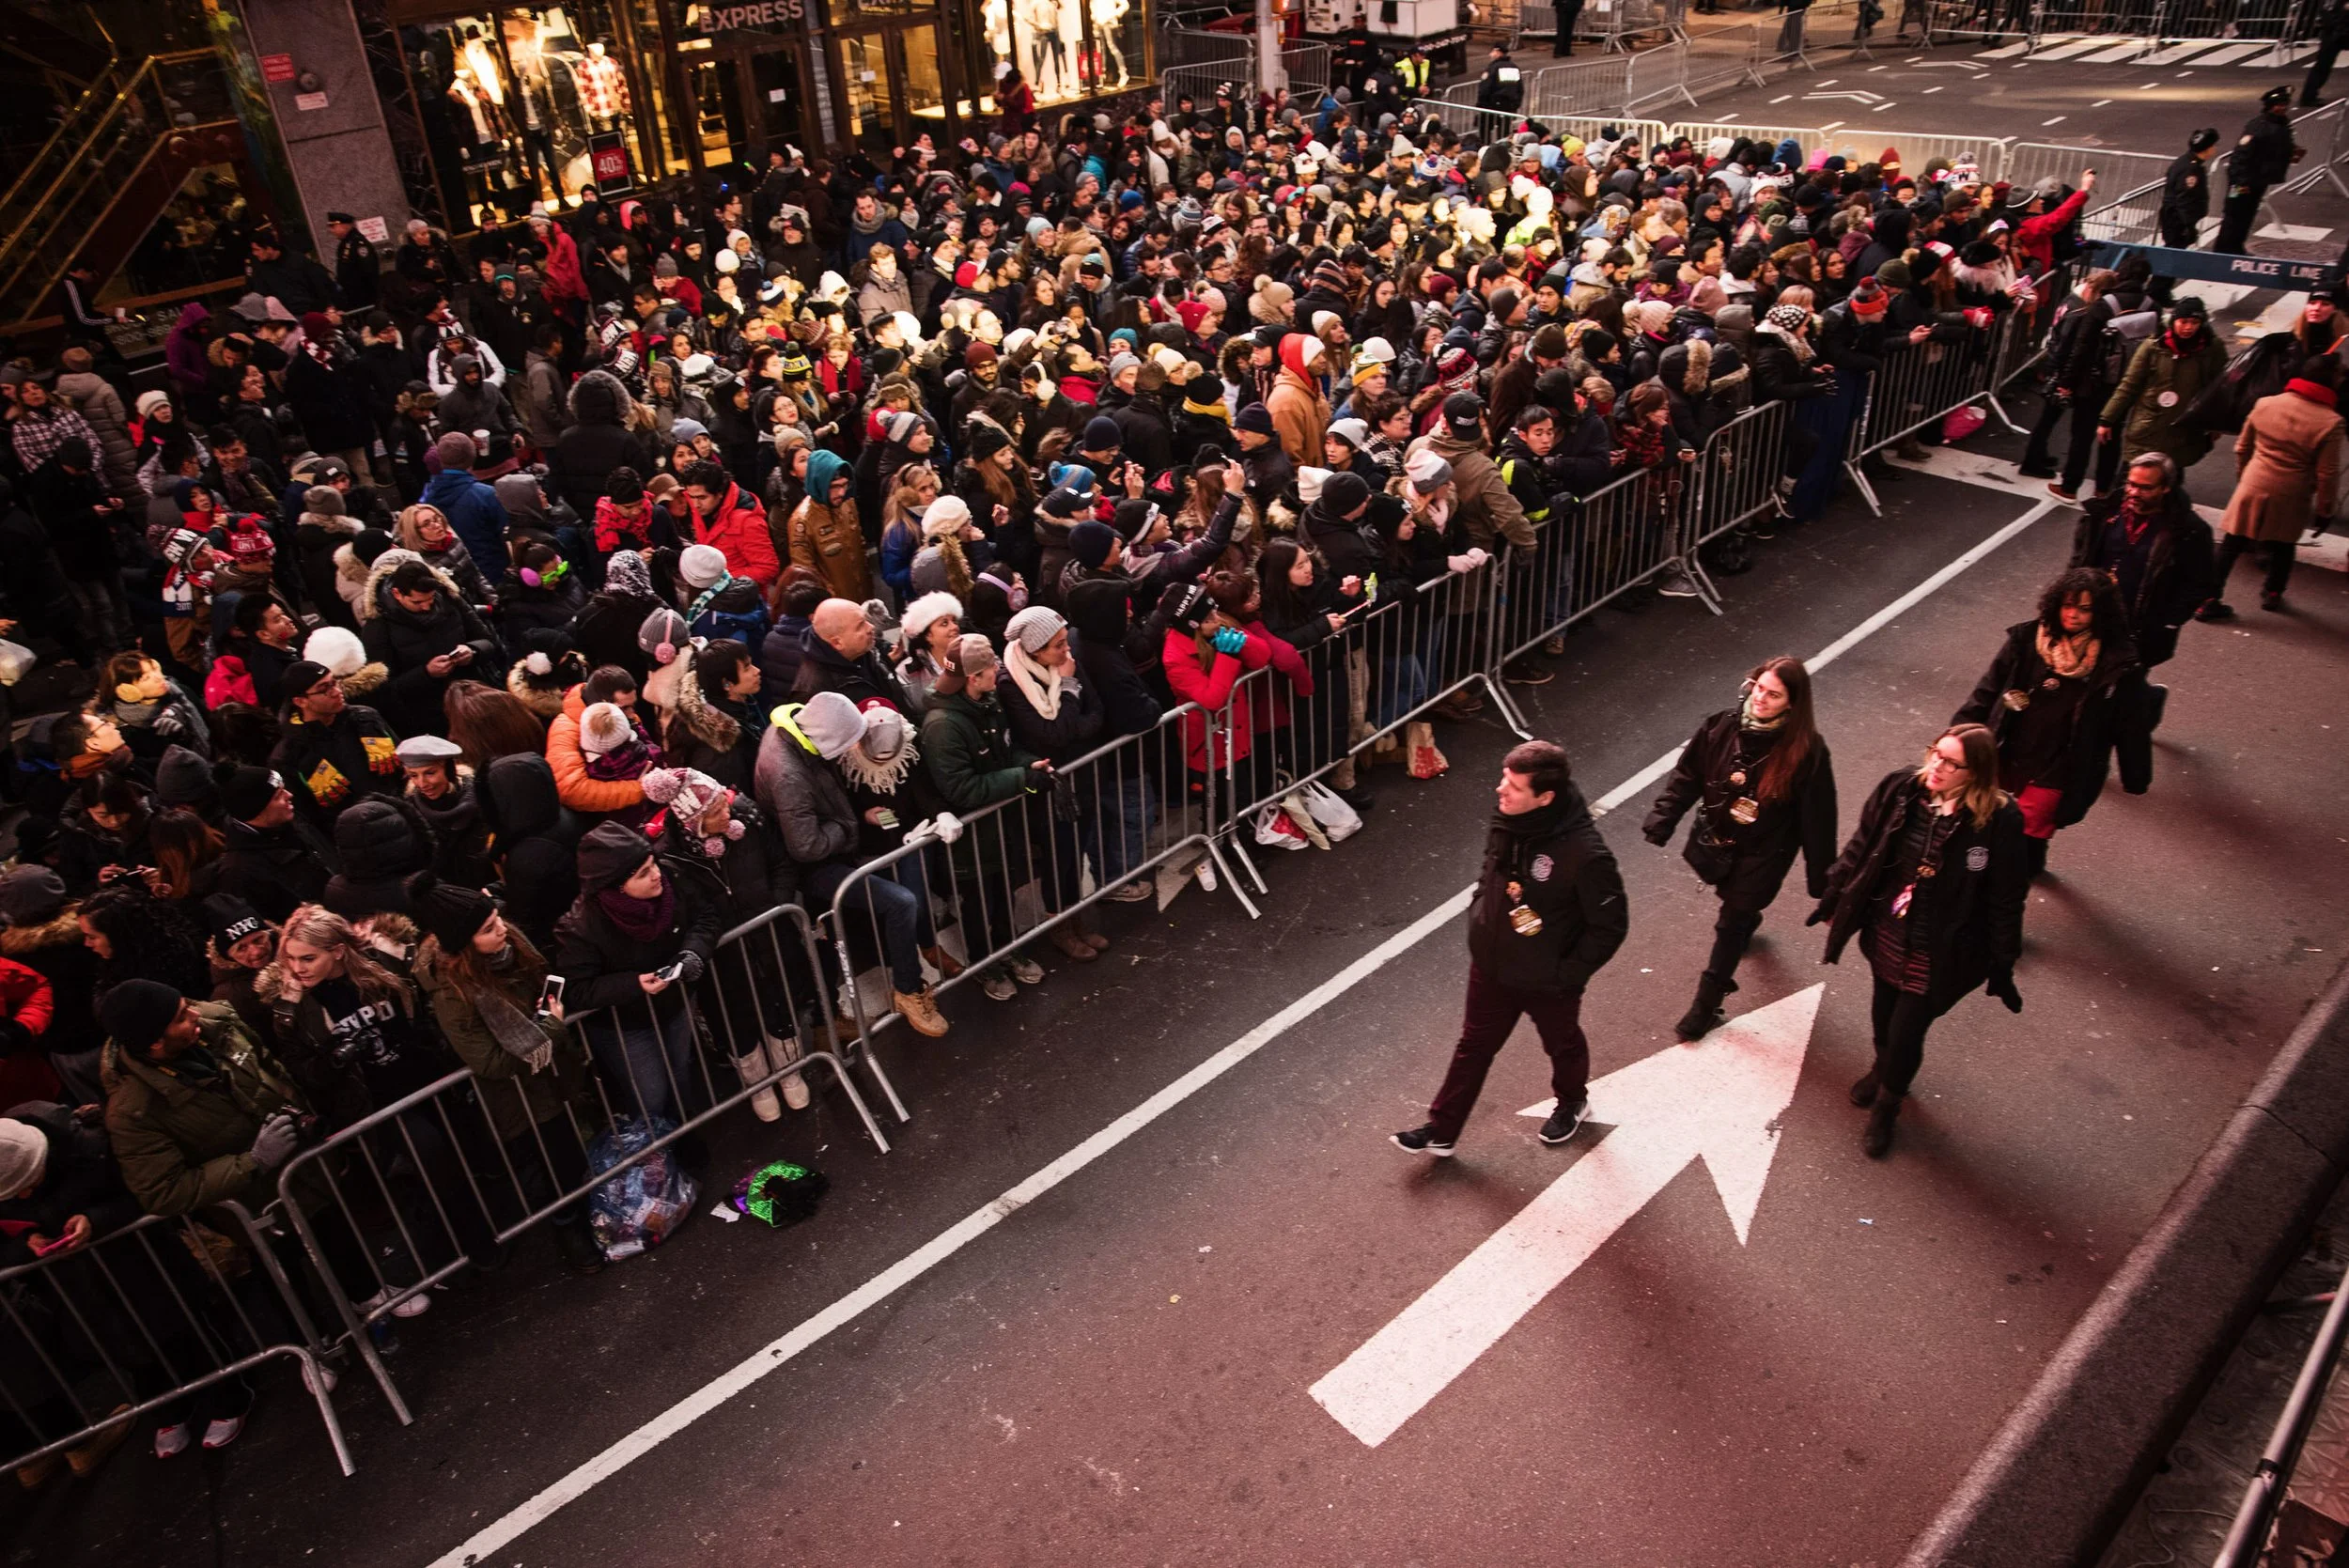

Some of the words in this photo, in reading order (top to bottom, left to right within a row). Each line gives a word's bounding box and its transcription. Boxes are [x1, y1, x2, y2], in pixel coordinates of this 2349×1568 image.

[699, 0, 804, 33] EXPRESS
[2231, 259, 2281, 275] POLICE
[2290, 265, 2325, 280] LINE
[1174, 594, 1193, 617] HAPPY
[225, 916, 260, 940] NYC
